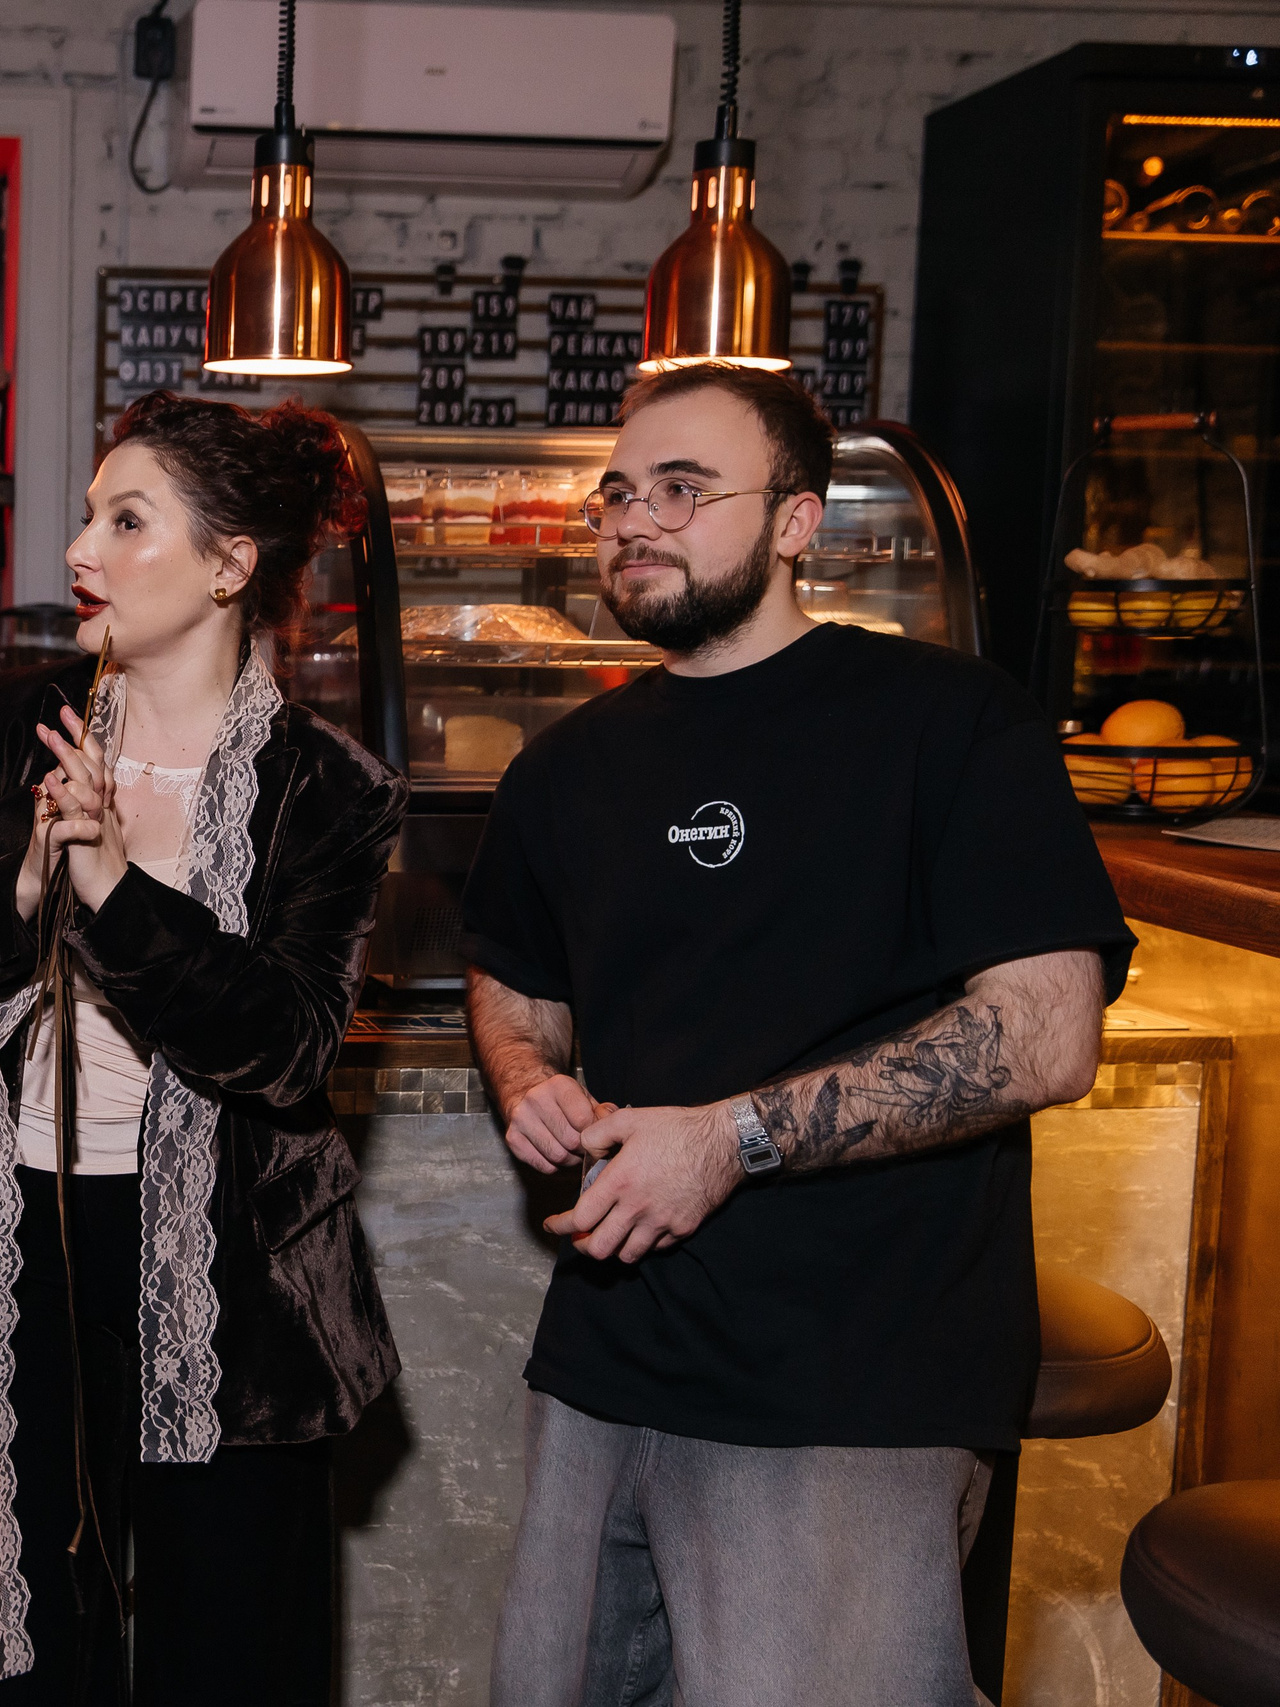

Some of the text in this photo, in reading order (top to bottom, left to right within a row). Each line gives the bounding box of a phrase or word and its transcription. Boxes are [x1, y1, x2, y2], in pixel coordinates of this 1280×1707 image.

[477, 295, 516, 317] 159
[550, 296, 595, 320] ЧАЙ
[121, 325, 515, 354] КАПУЧ 189 219
[119, 360, 181, 384] ФЛЭТ
[421, 367, 464, 390] 209
[548, 369, 624, 392] КАКАО
[823, 372, 866, 395] 209
[420, 401, 513, 426] 209 239
[668, 825, 730, 843] Онегин
[719, 807, 740, 859] КРЕПКИЙ КОФЕ
